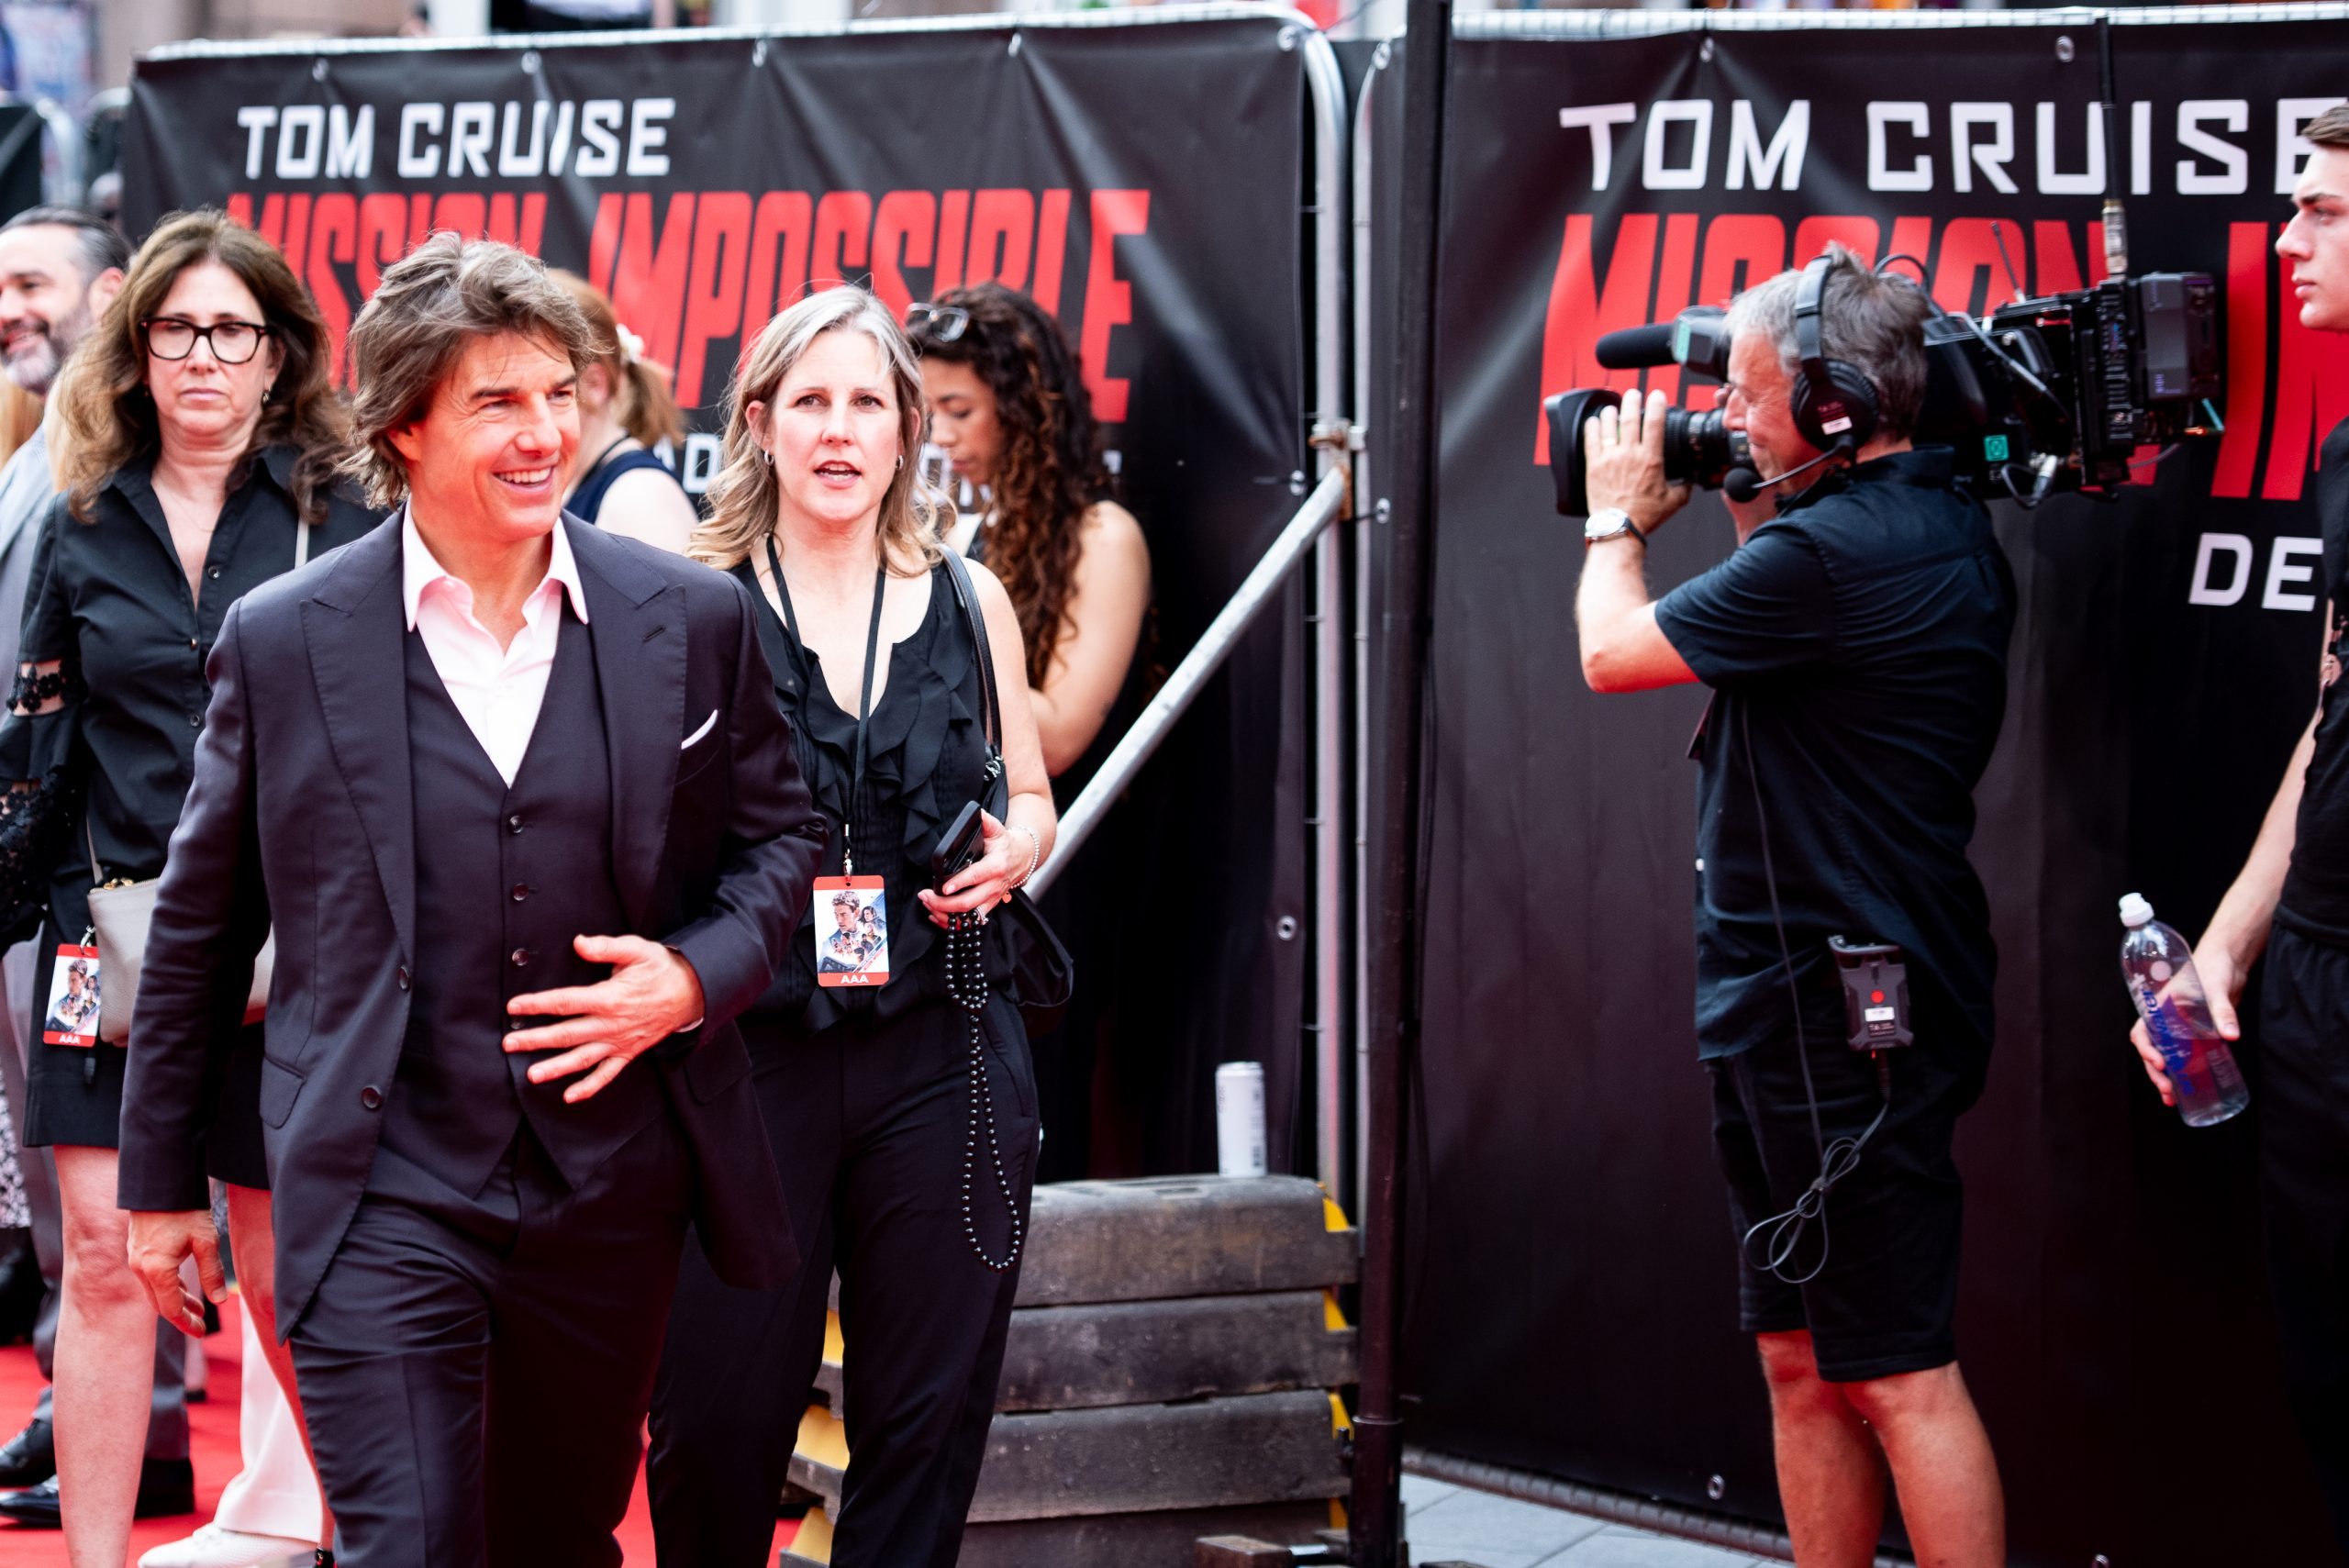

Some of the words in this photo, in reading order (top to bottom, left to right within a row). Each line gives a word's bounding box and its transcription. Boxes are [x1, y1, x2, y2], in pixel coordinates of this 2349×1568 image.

[236, 104, 374, 180] TOM
[396, 97, 677, 179] CRUISE
[1559, 99, 1810, 191] TOM
[1865, 97, 2349, 195] CRUISE
[841, 975, 868, 984] AAA
[60, 1034, 80, 1044] AAA
